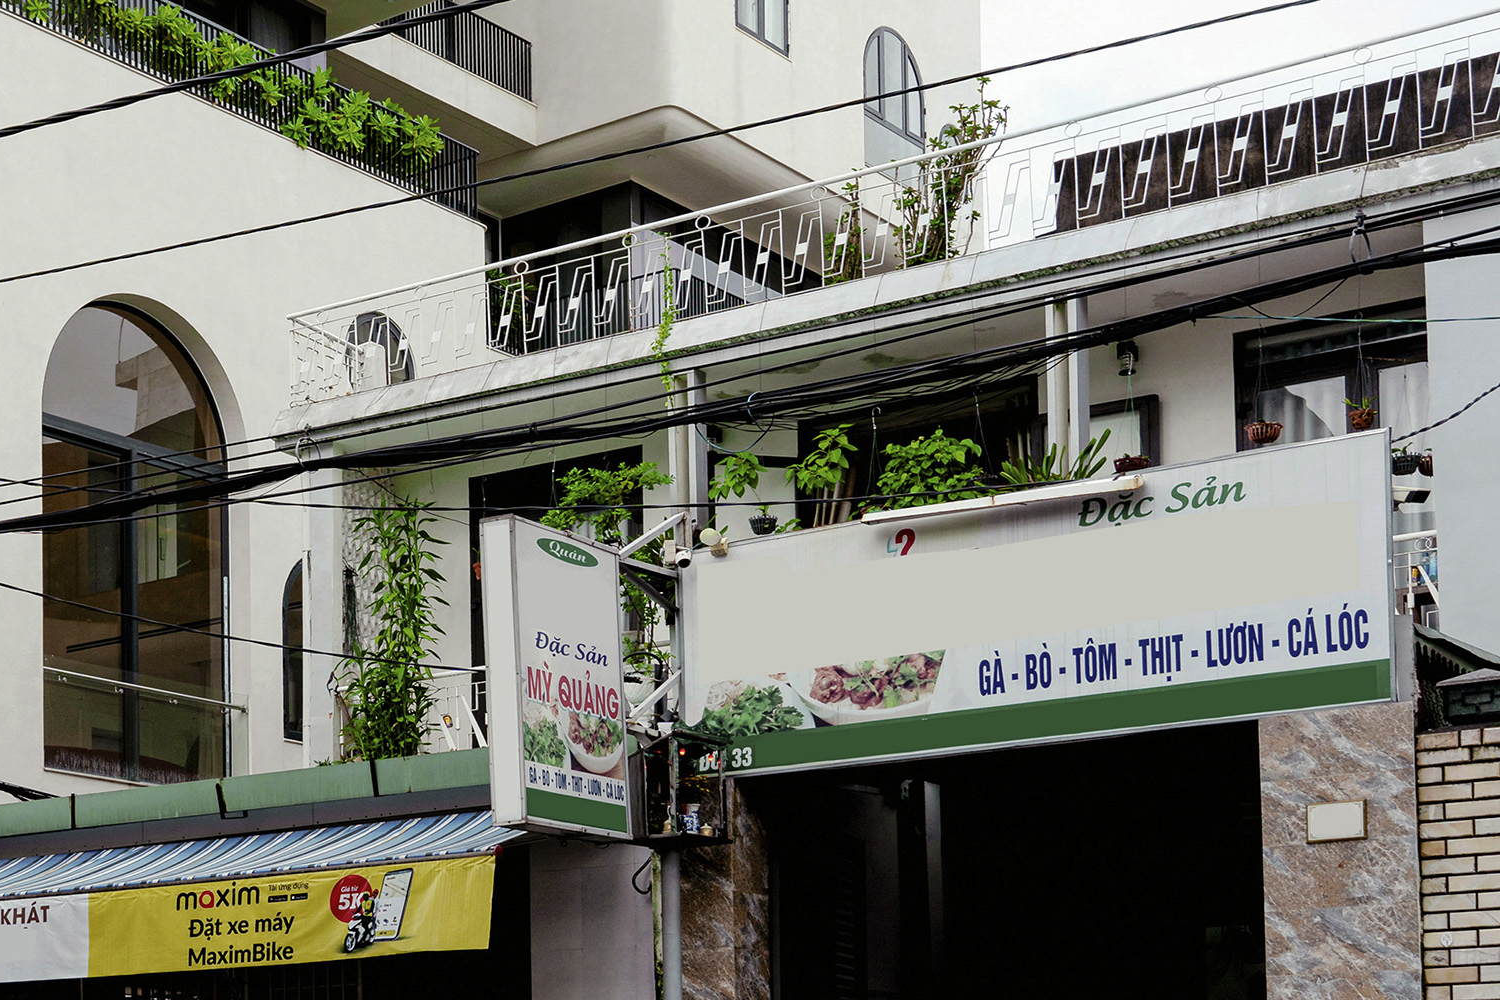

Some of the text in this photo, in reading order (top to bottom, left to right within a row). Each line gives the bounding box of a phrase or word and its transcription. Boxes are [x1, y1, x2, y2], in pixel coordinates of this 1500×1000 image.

[1078, 475, 1246, 527] Đặc Sản
[549, 540, 587, 563] Quán
[535, 631, 609, 667] Đặc Sản
[978, 650, 1006, 696] GÀ
[1025, 643, 1052, 690] BÒ
[1073, 638, 1118, 684] TÔM
[1138, 634, 1184, 682] THỊT
[1206, 622, 1265, 668] LƯƠN
[1287, 608, 1319, 658] CÁ
[1325, 603, 1370, 653] LÓC
[526, 660, 620, 720] MỲ QUẢNG
[731, 747, 752, 768] 33
[529, 764, 538, 784] GÀ
[542, 766, 551, 787] BÒ
[555, 769, 567, 790] TÔM
[571, 775, 583, 796] THỊT
[606, 780, 614, 799] CÁ
[614, 781, 625, 801] LÓC
[176, 881, 260, 911] maxim
[0, 901, 50, 925] KHÁT
[188, 911, 295, 941] Đặt xe máy
[188, 941, 294, 967] MaximBike
